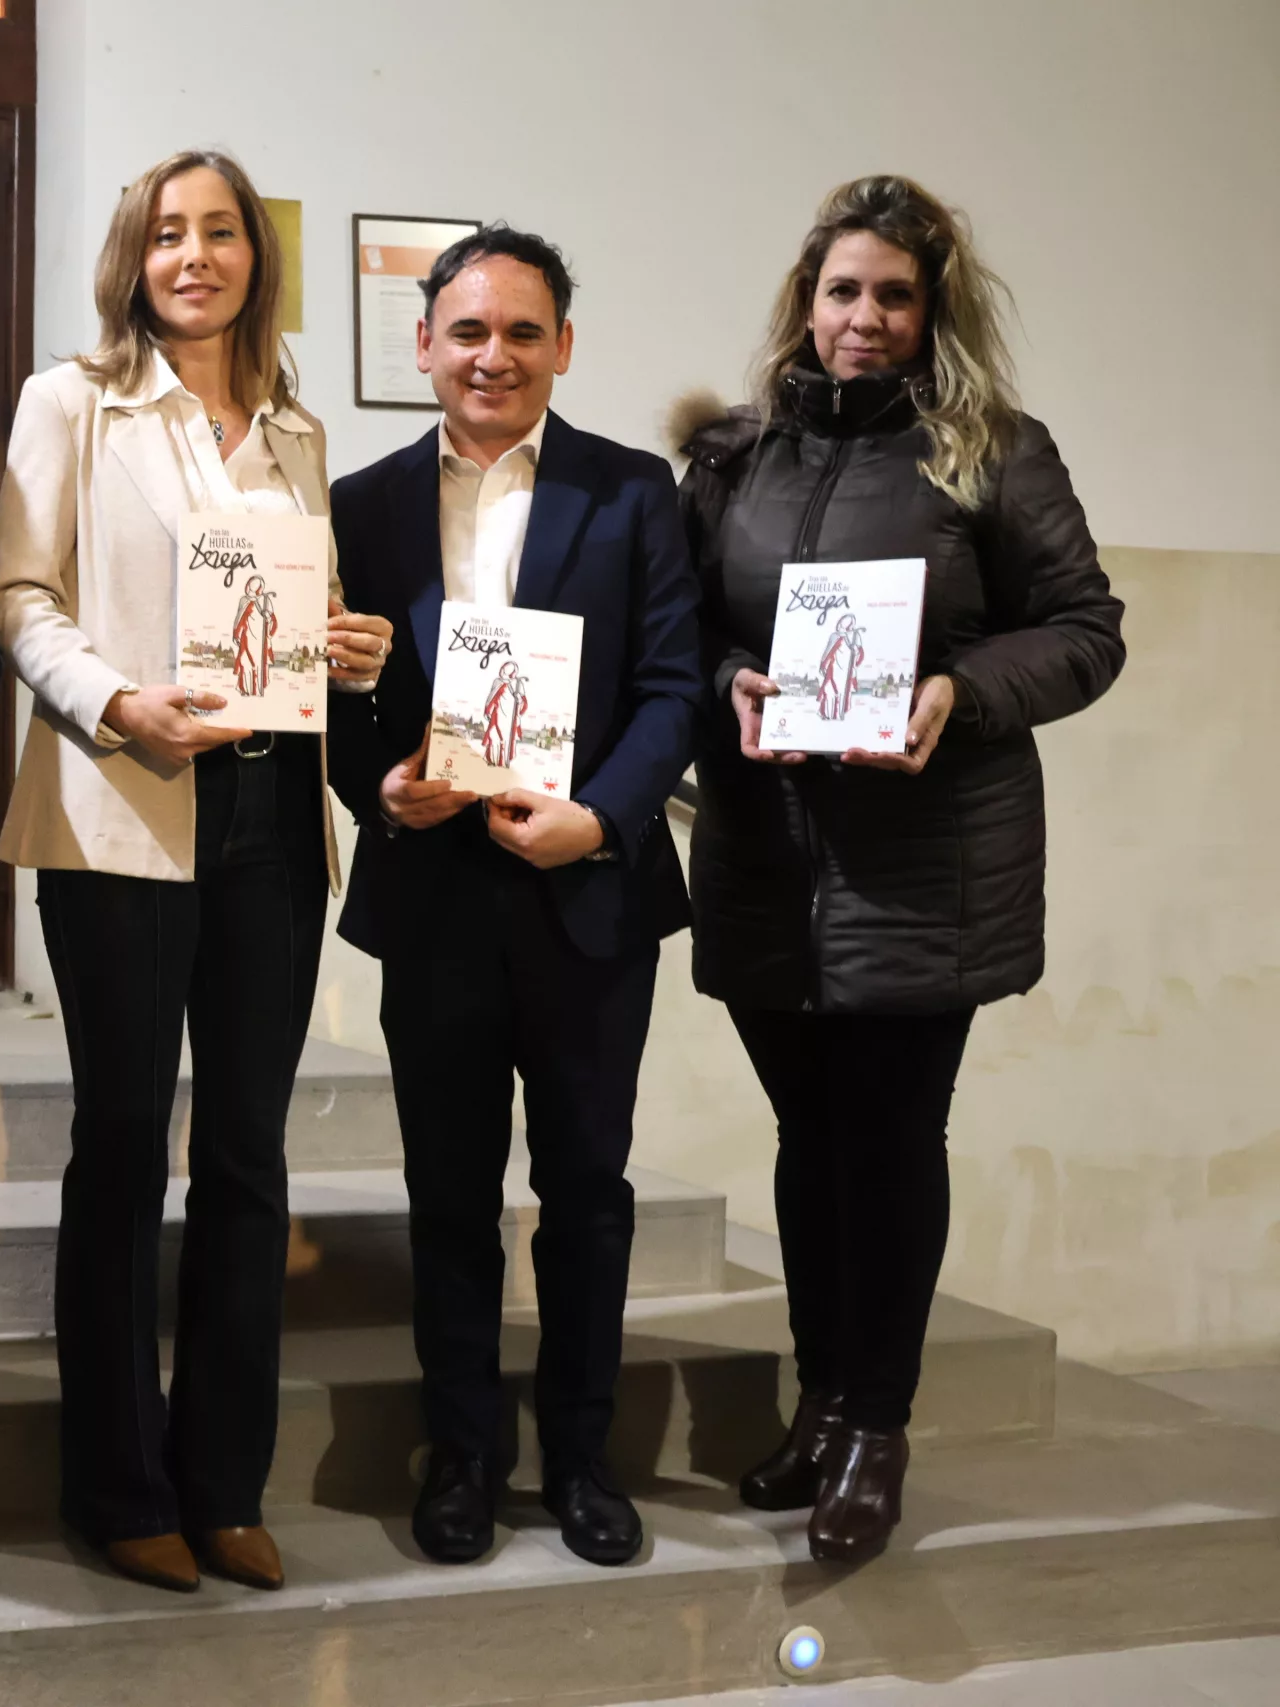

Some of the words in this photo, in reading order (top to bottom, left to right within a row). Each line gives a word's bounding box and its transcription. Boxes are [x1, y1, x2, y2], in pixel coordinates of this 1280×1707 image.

[209, 537, 246, 549] HUELLAS
[807, 583, 842, 593] HUELLAS
[469, 625, 505, 638] HUELLAS
